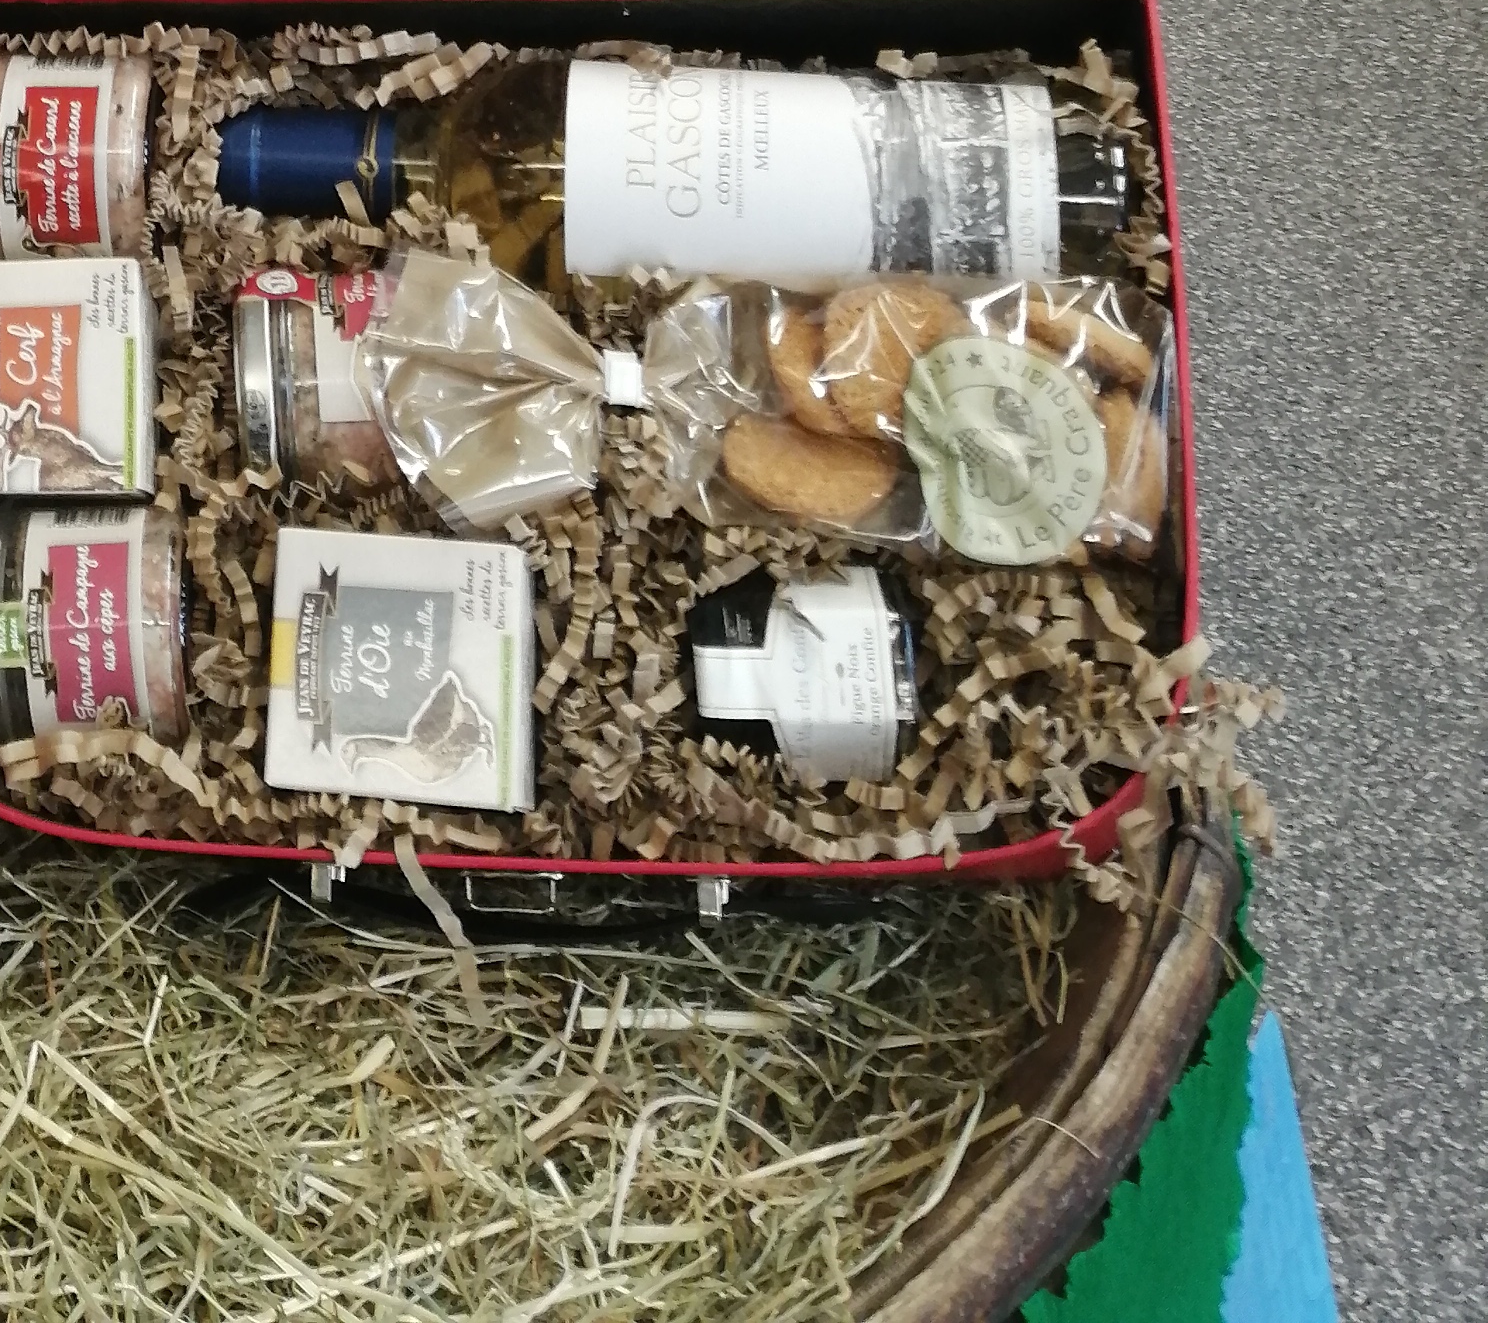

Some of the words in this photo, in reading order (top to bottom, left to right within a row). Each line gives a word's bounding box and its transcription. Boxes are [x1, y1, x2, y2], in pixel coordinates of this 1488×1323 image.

[717, 128, 731, 148] DE
[714, 153, 732, 206] CÔTES
[5, 321, 45, 386] Cerf
[66, 544, 98, 629] Campagne
[68, 633, 89, 652] de
[296, 598, 317, 654] VEYRAC
[71, 657, 97, 720] Terrine
[329, 624, 354, 694] Terrine
[356, 622, 392, 699] d'Oie
[297, 676, 315, 715] JEAN
